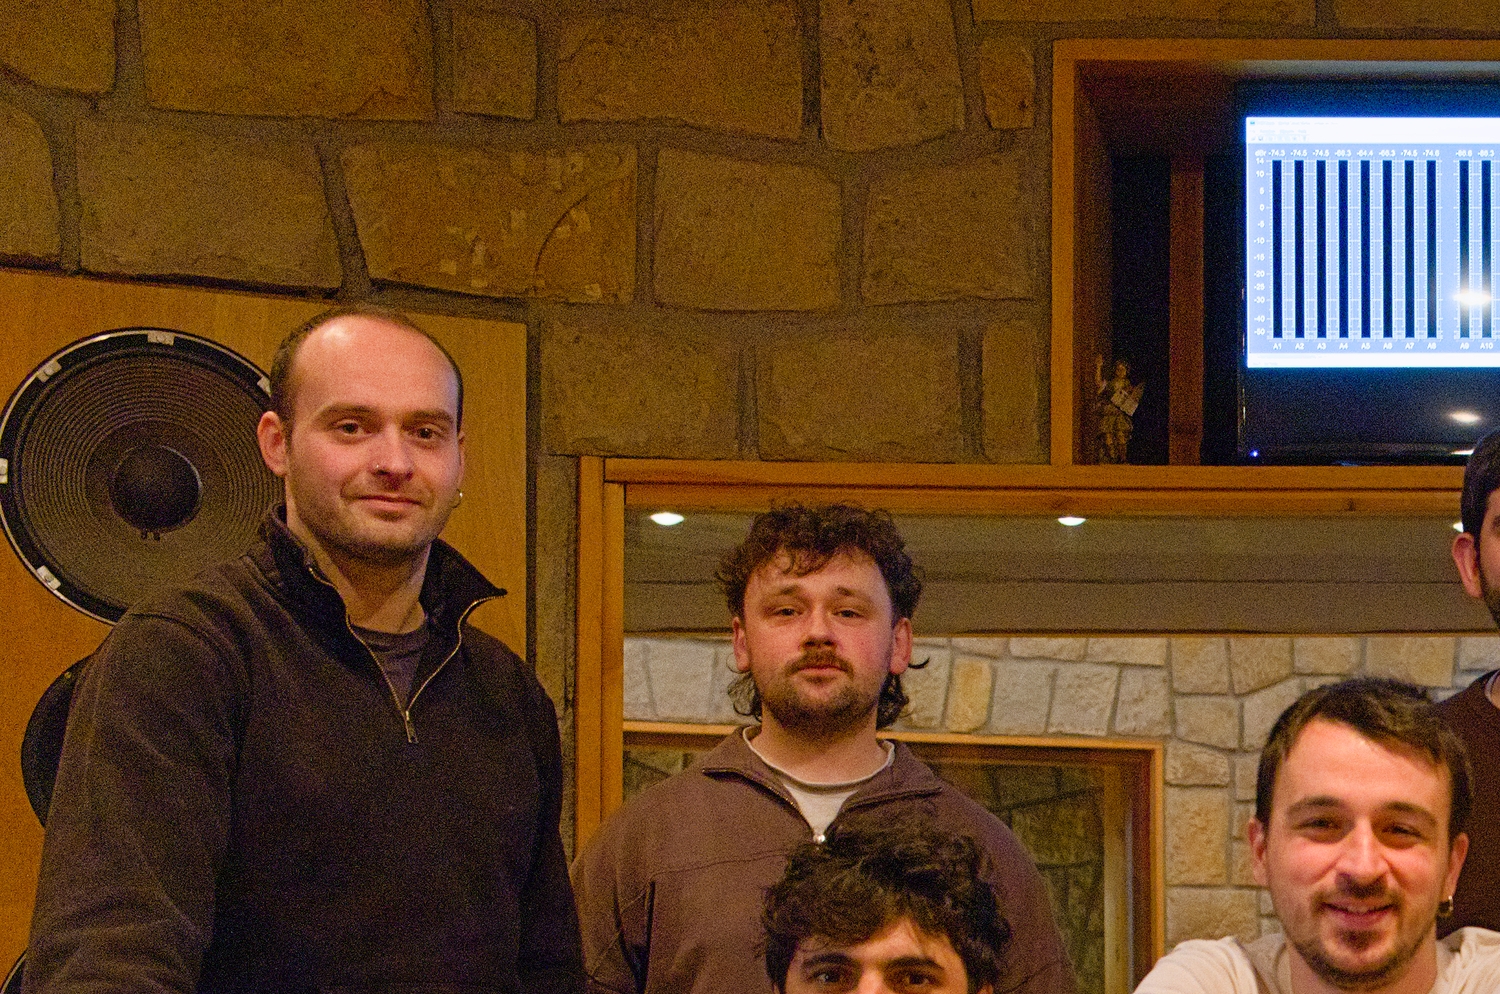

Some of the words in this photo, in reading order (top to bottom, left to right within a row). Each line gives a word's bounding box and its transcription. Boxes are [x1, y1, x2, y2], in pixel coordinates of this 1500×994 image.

[1272, 342, 1282, 350] A1
[1294, 342, 1305, 350] A2
[1316, 342, 1327, 350] A3
[1404, 342, 1415, 350] A7
[1479, 342, 1494, 350] A10
